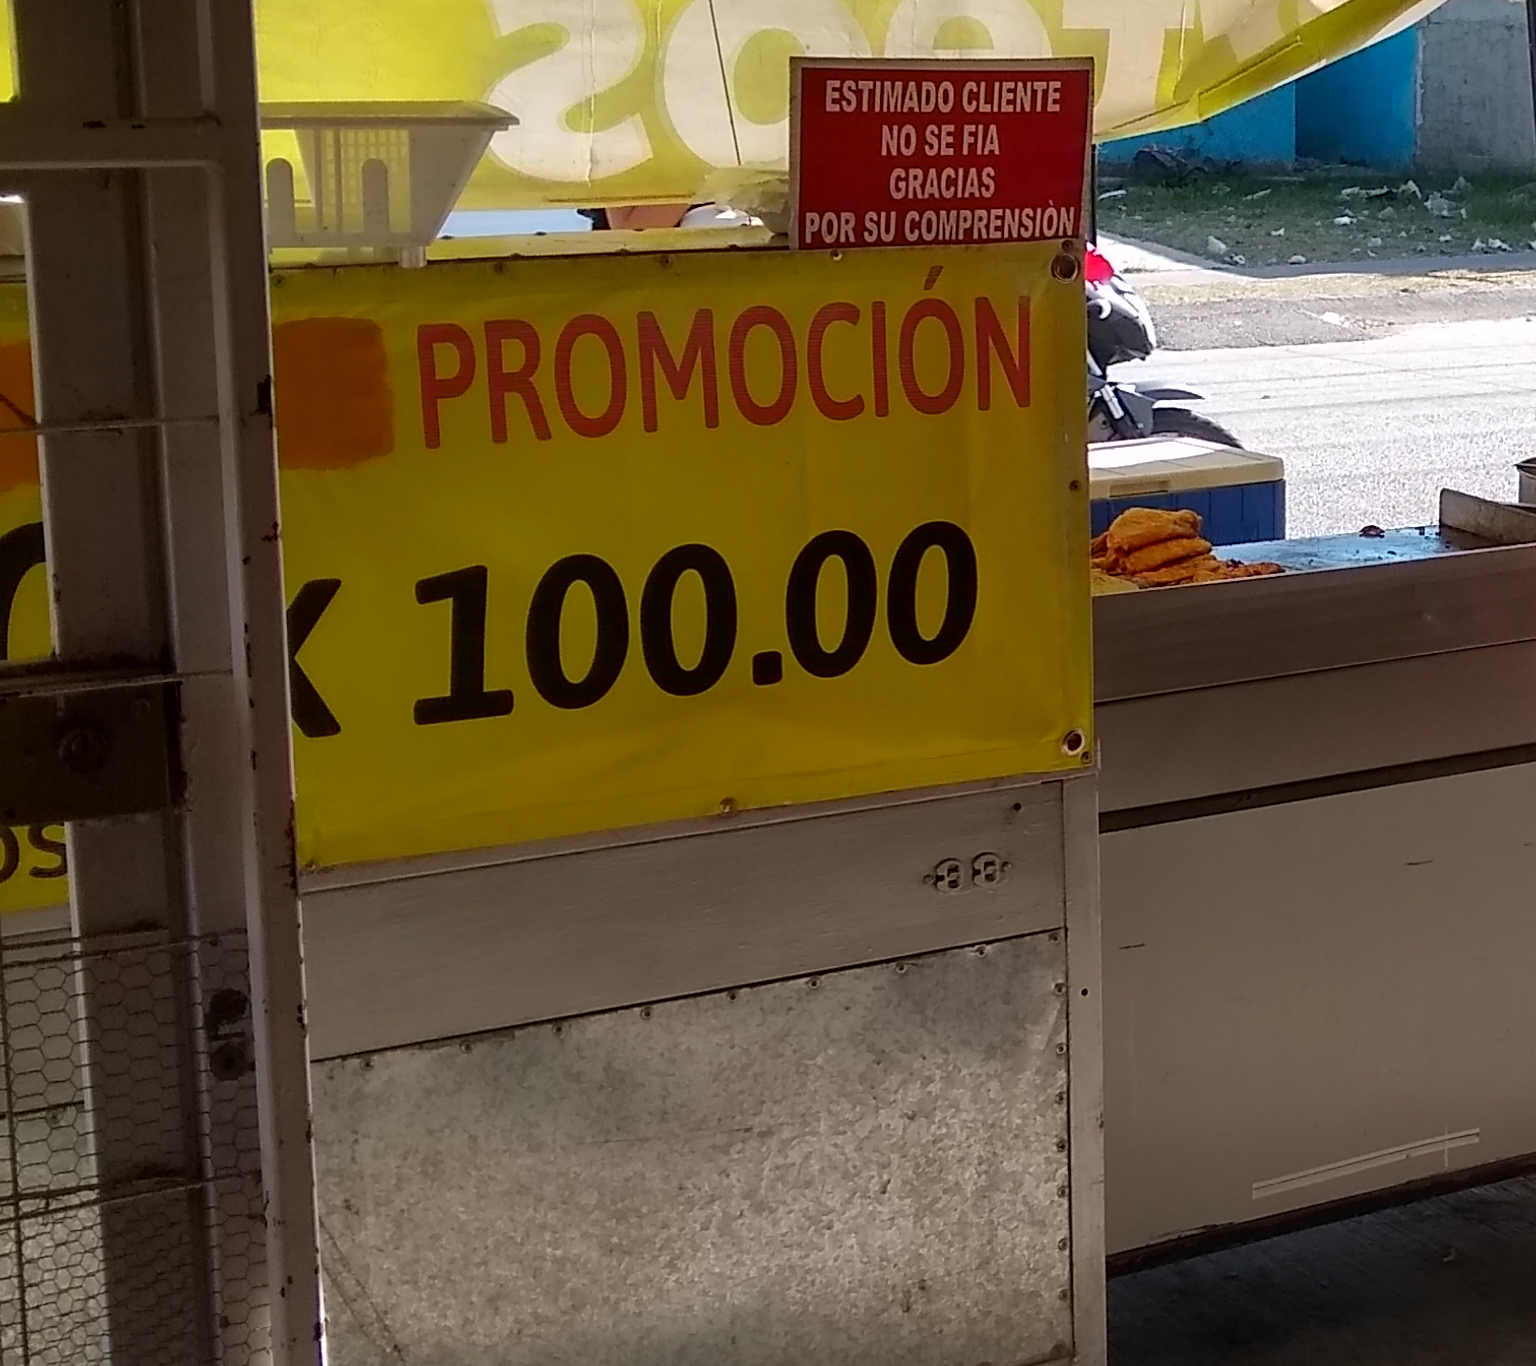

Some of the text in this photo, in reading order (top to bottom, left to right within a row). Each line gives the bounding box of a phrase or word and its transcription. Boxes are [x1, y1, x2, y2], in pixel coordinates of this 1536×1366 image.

[825, 80, 1062, 114] ESTIMADO CLIENTE
[881, 124, 1001, 157] NO SE FIA
[889, 166, 996, 199] GRACIAS
[805, 211, 856, 244] POR
[863, 210, 897, 243] SU
[417, 264, 1033, 449] PROMOCIÓN
[413, 520, 980, 725] 100.00
